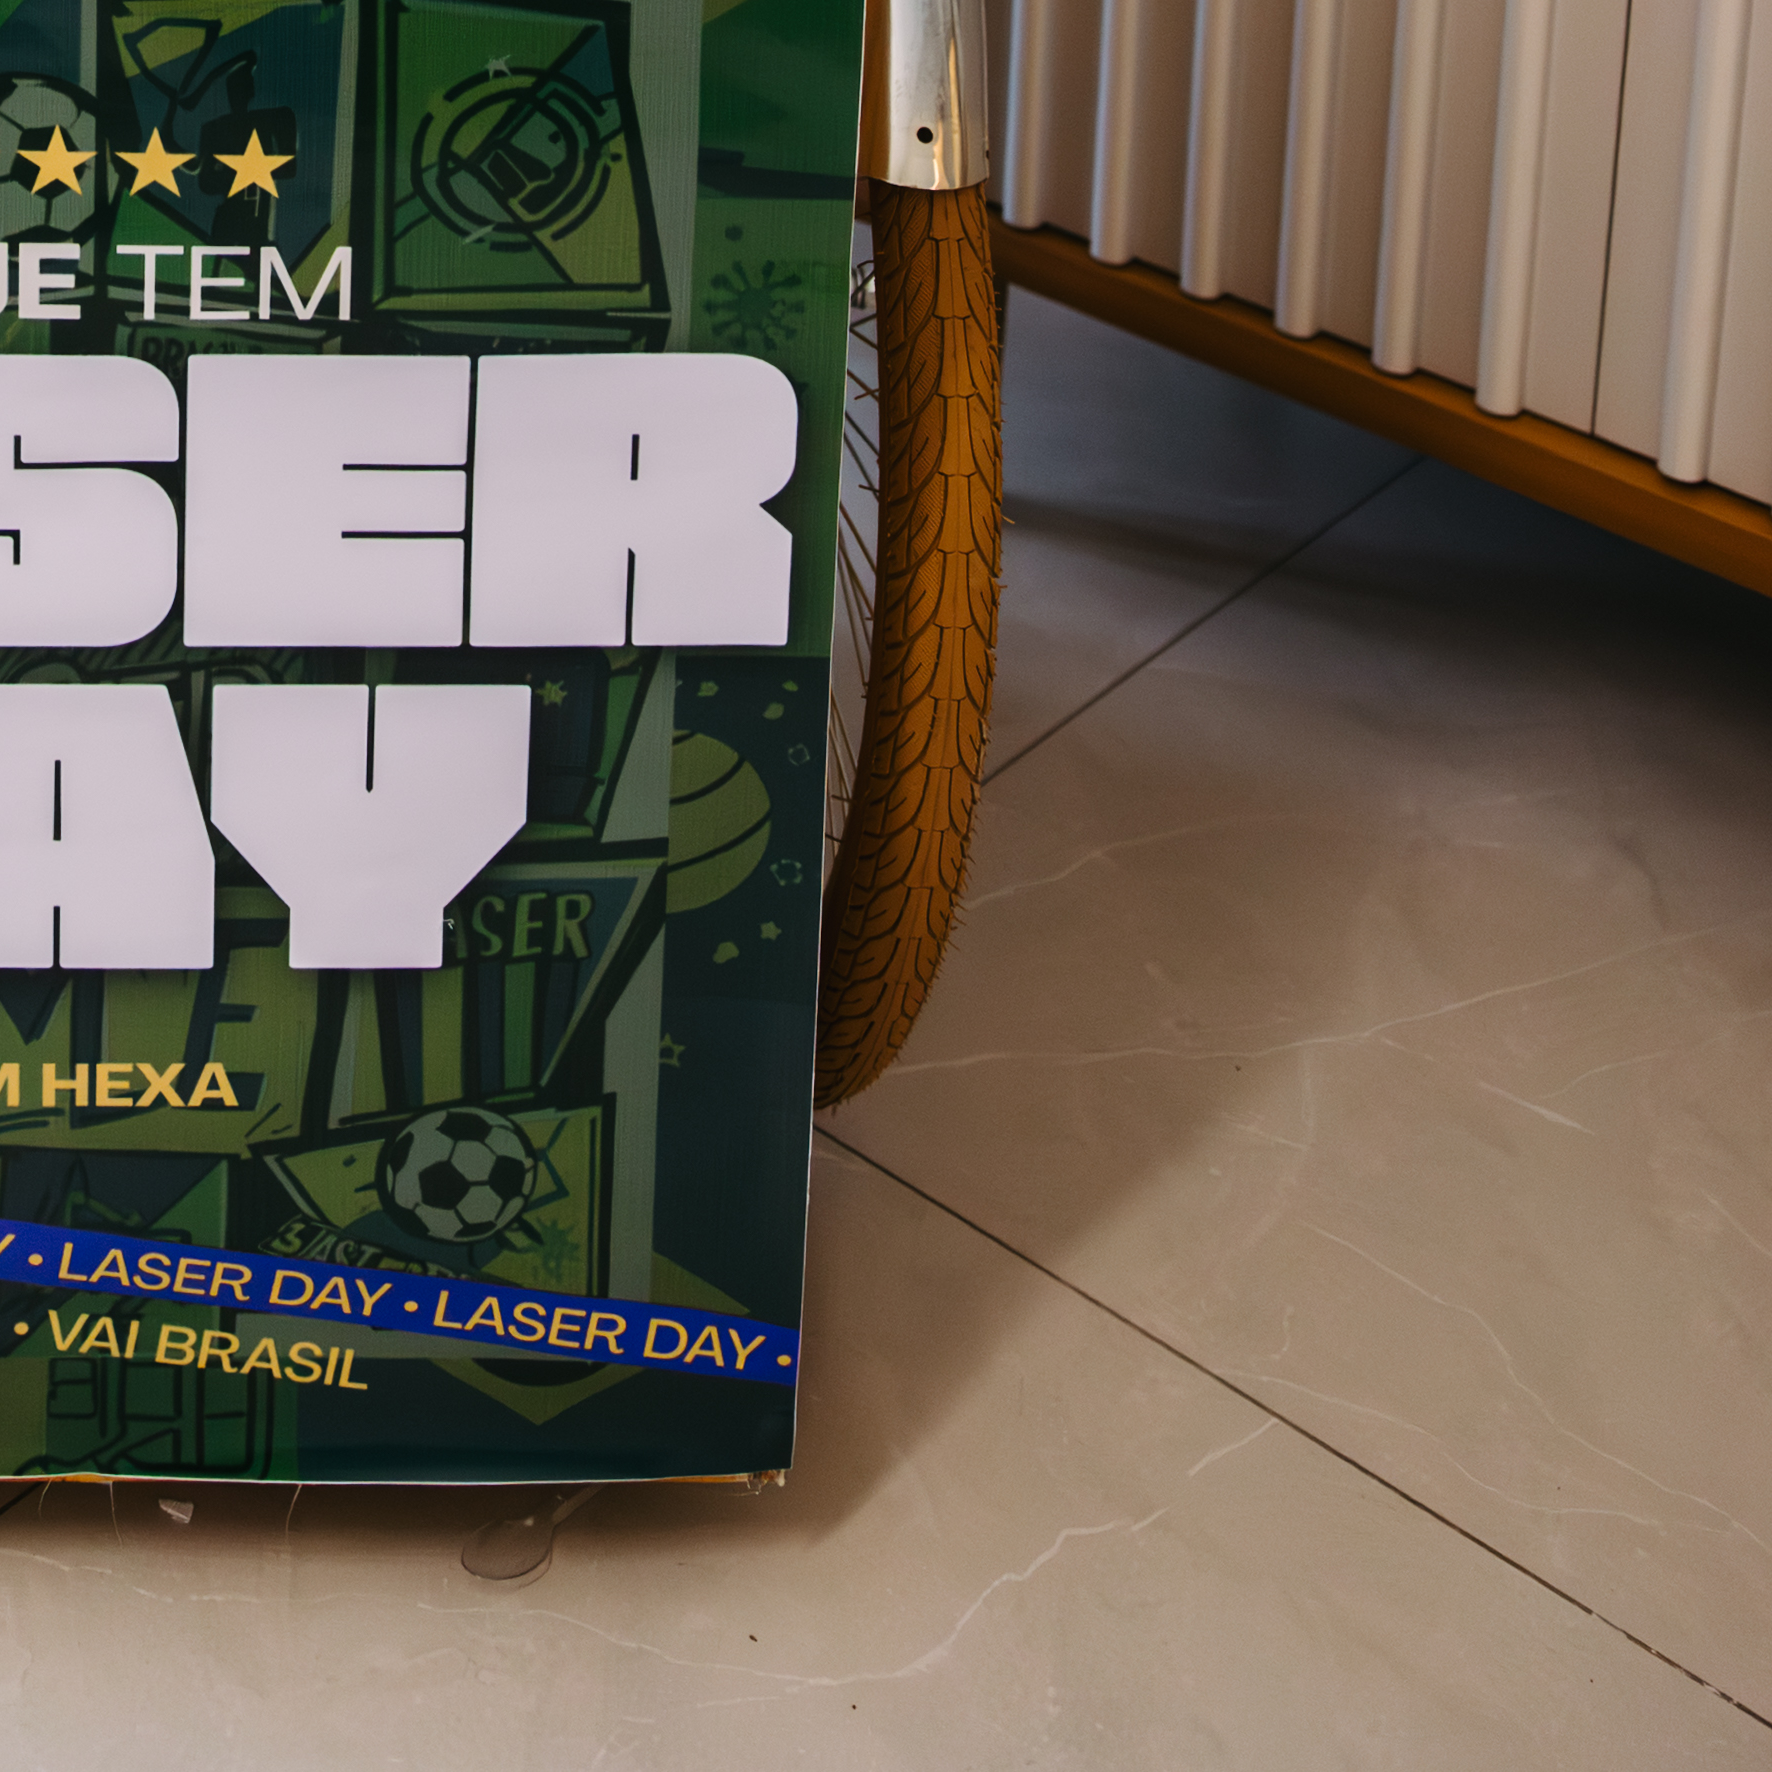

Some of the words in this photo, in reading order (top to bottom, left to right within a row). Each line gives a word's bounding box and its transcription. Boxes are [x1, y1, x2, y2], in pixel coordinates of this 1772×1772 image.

[117, 246, 353, 321] TEM
[41, 1062, 240, 1108] HEXA
[58, 1242, 250, 1301] LASER
[269, 1270, 393, 1317] DAY
[433, 1291, 628, 1354] LASER
[643, 1318, 766, 1372] DAY
[47, 1310, 138, 1358] VAI
[155, 1324, 368, 1390] BRASIL
